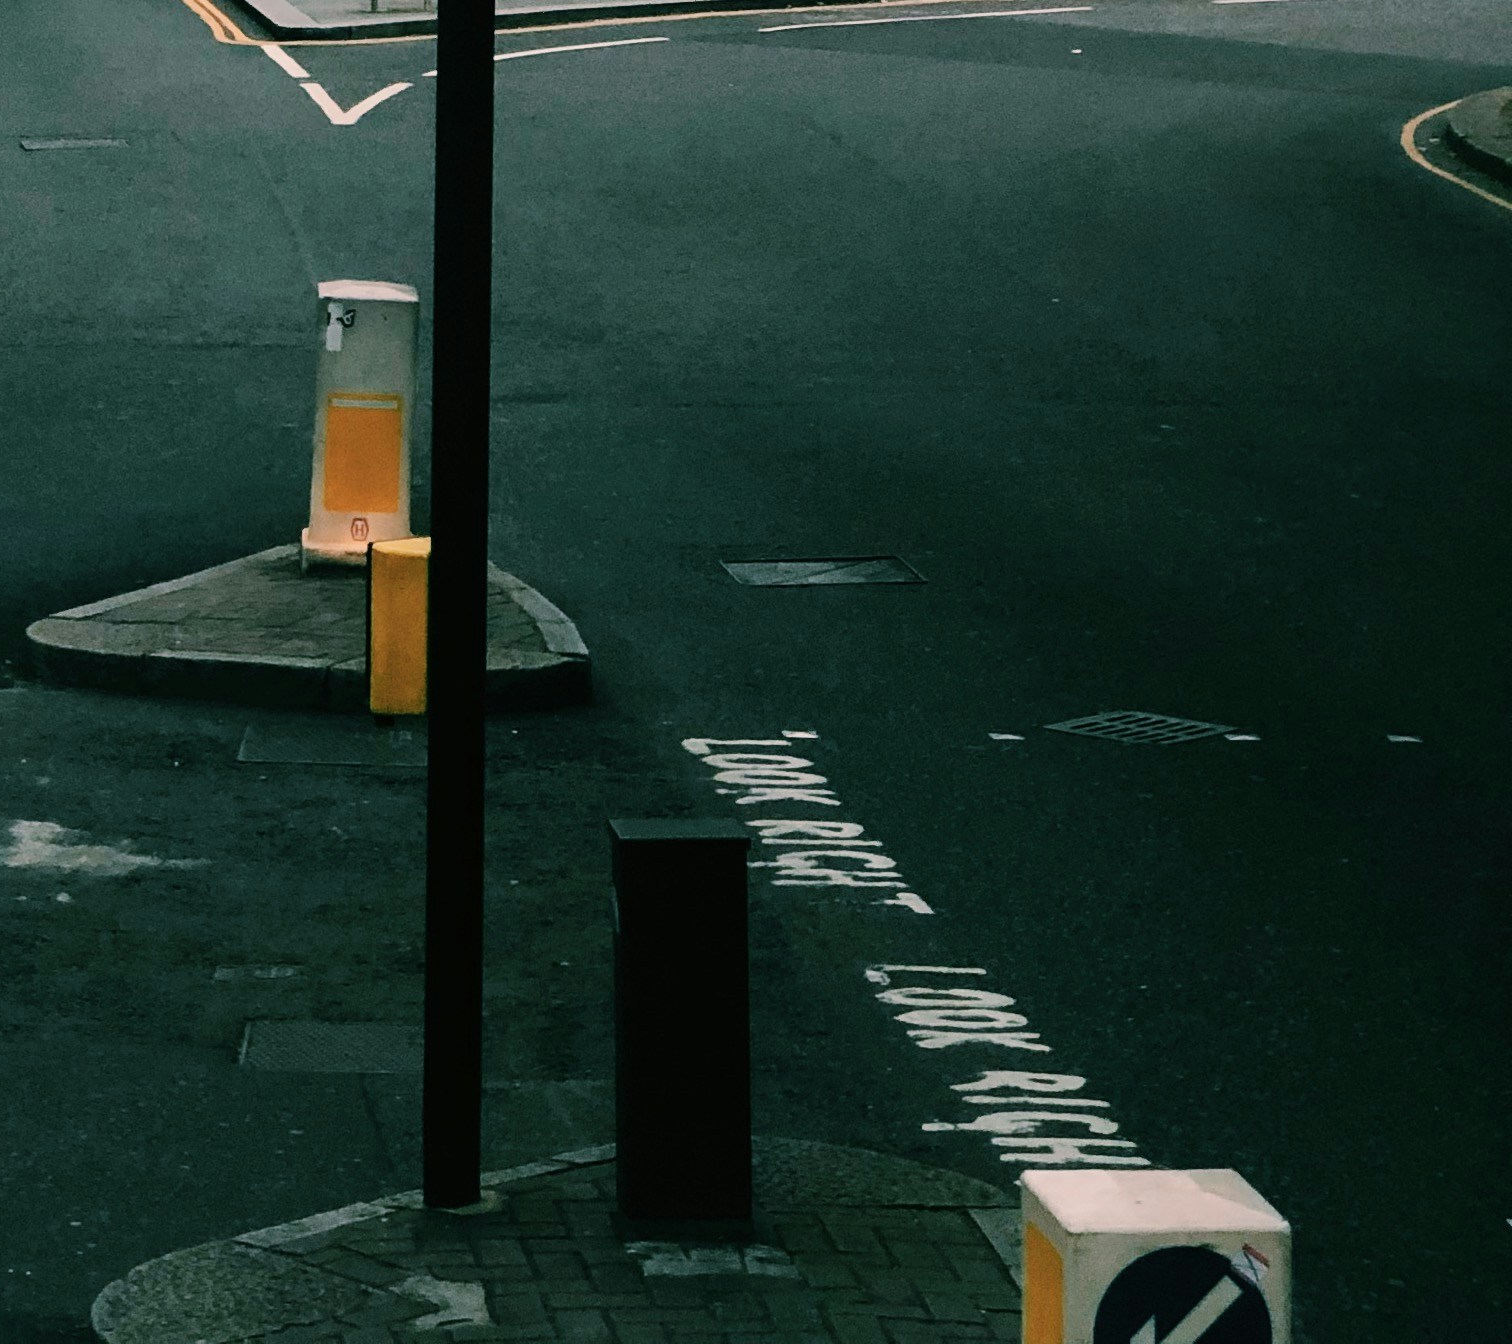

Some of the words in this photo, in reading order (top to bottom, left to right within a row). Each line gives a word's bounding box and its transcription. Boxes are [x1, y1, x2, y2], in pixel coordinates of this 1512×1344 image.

[681, 738, 842, 806] LOOK
[745, 819, 936, 915] RIGHT
[865, 964, 1055, 1052] LOOK
[921, 1070, 1152, 1166] RIGH
